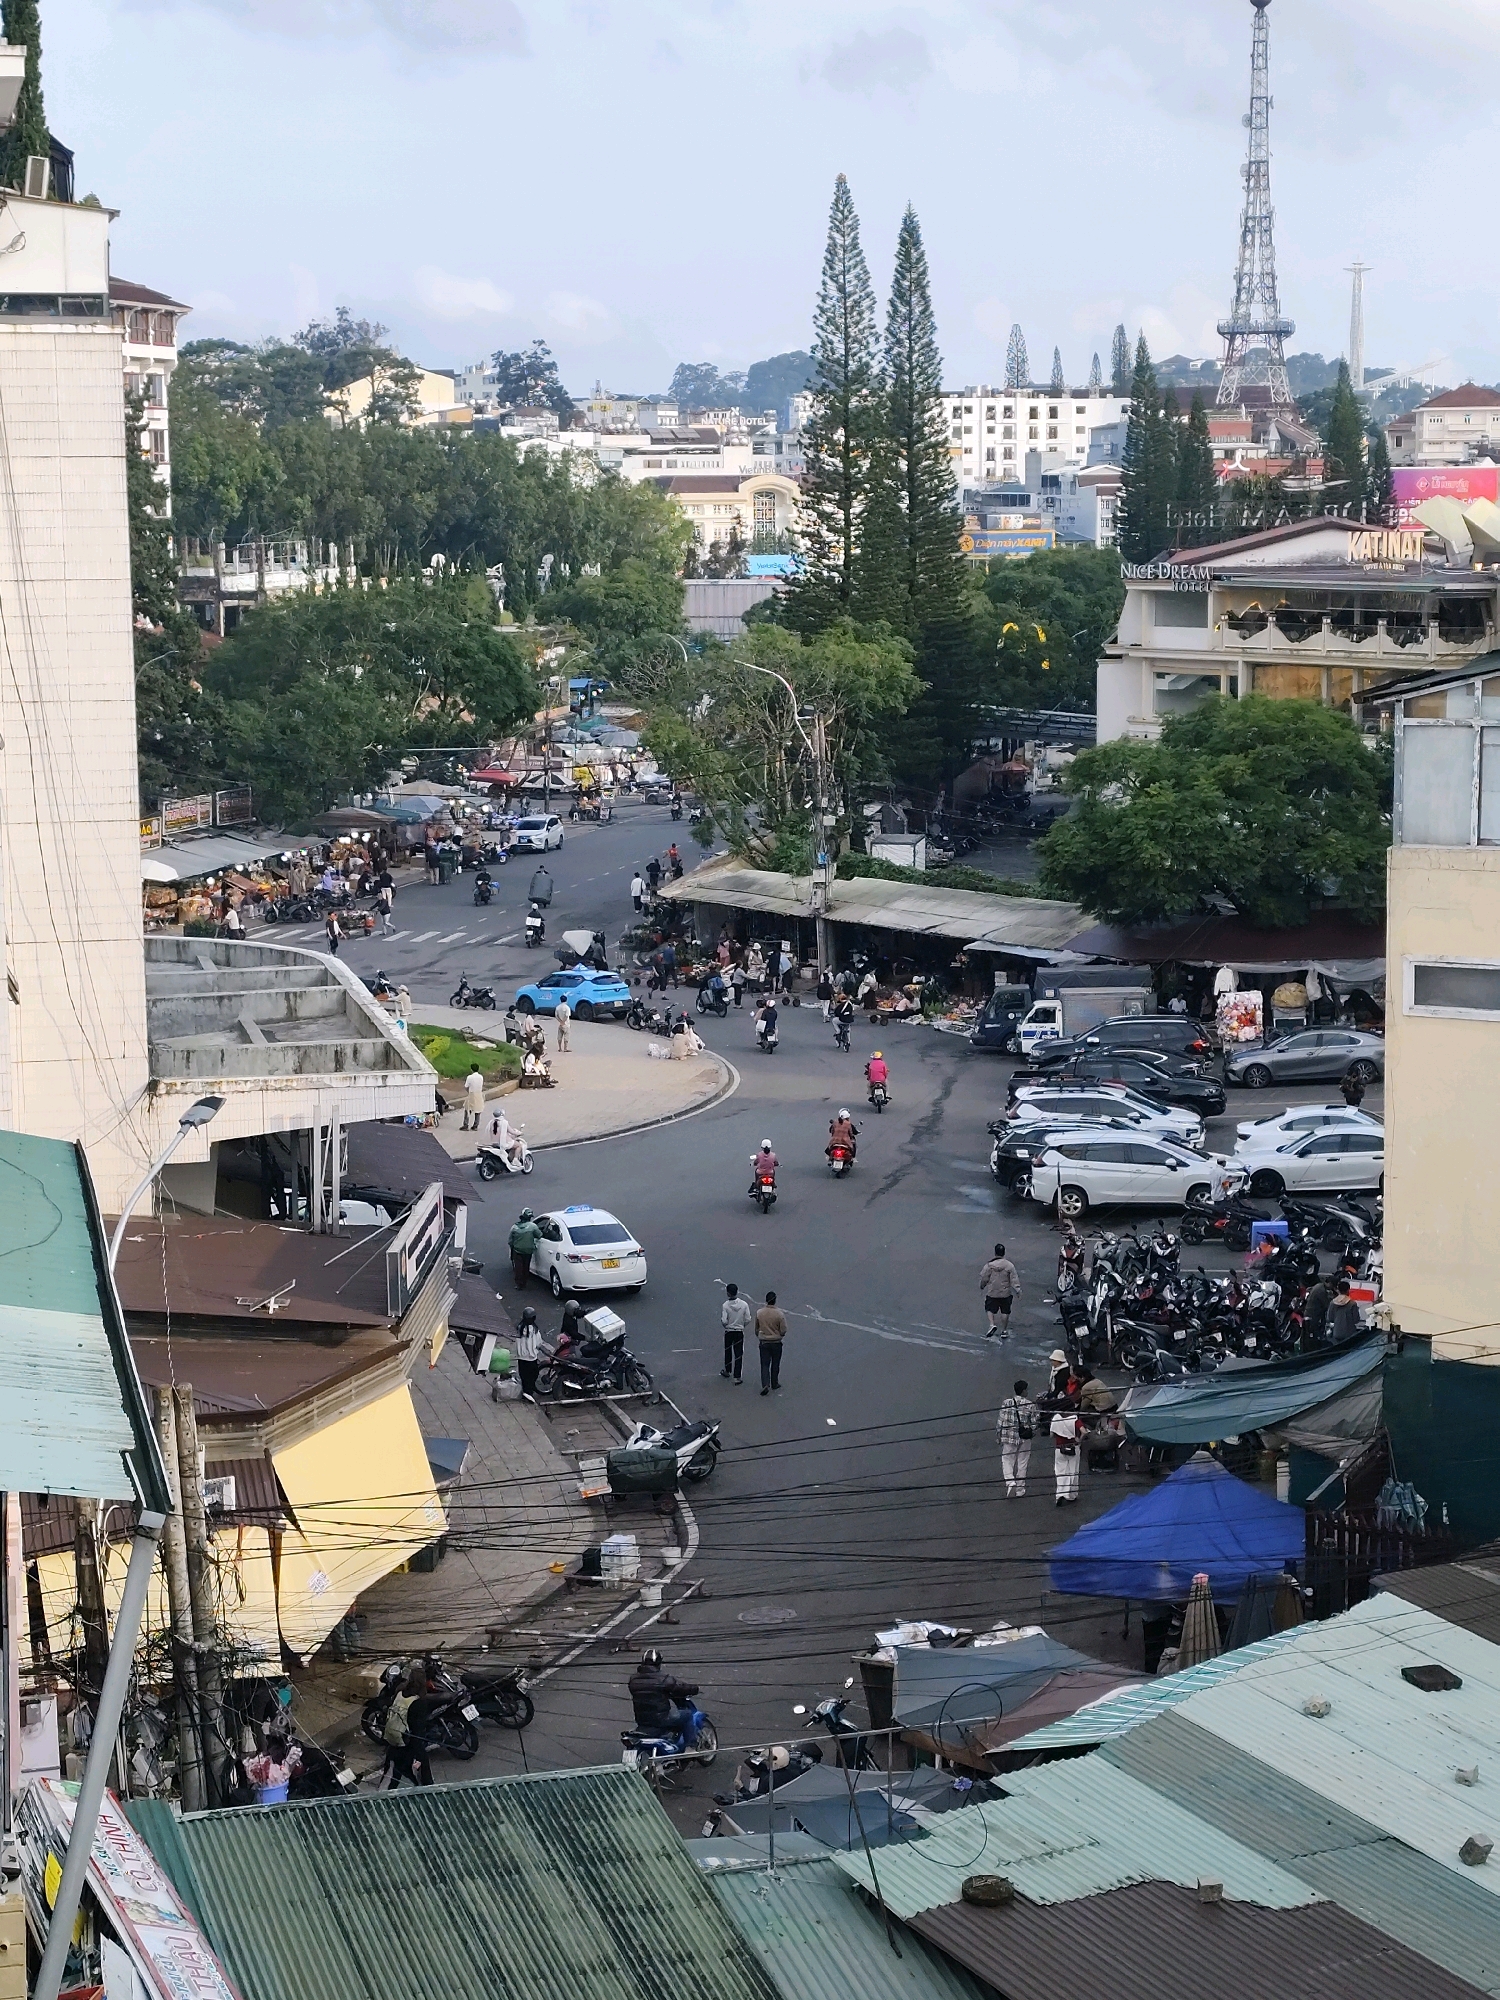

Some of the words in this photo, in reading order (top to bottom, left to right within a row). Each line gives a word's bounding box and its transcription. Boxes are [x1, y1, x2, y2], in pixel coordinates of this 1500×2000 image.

[1347, 531, 1425, 562] KATINAT
[1120, 563, 1155, 579] NICE
[1158, 562, 1212, 580] DREAM
[1172, 581, 1212, 593] HOTEL
